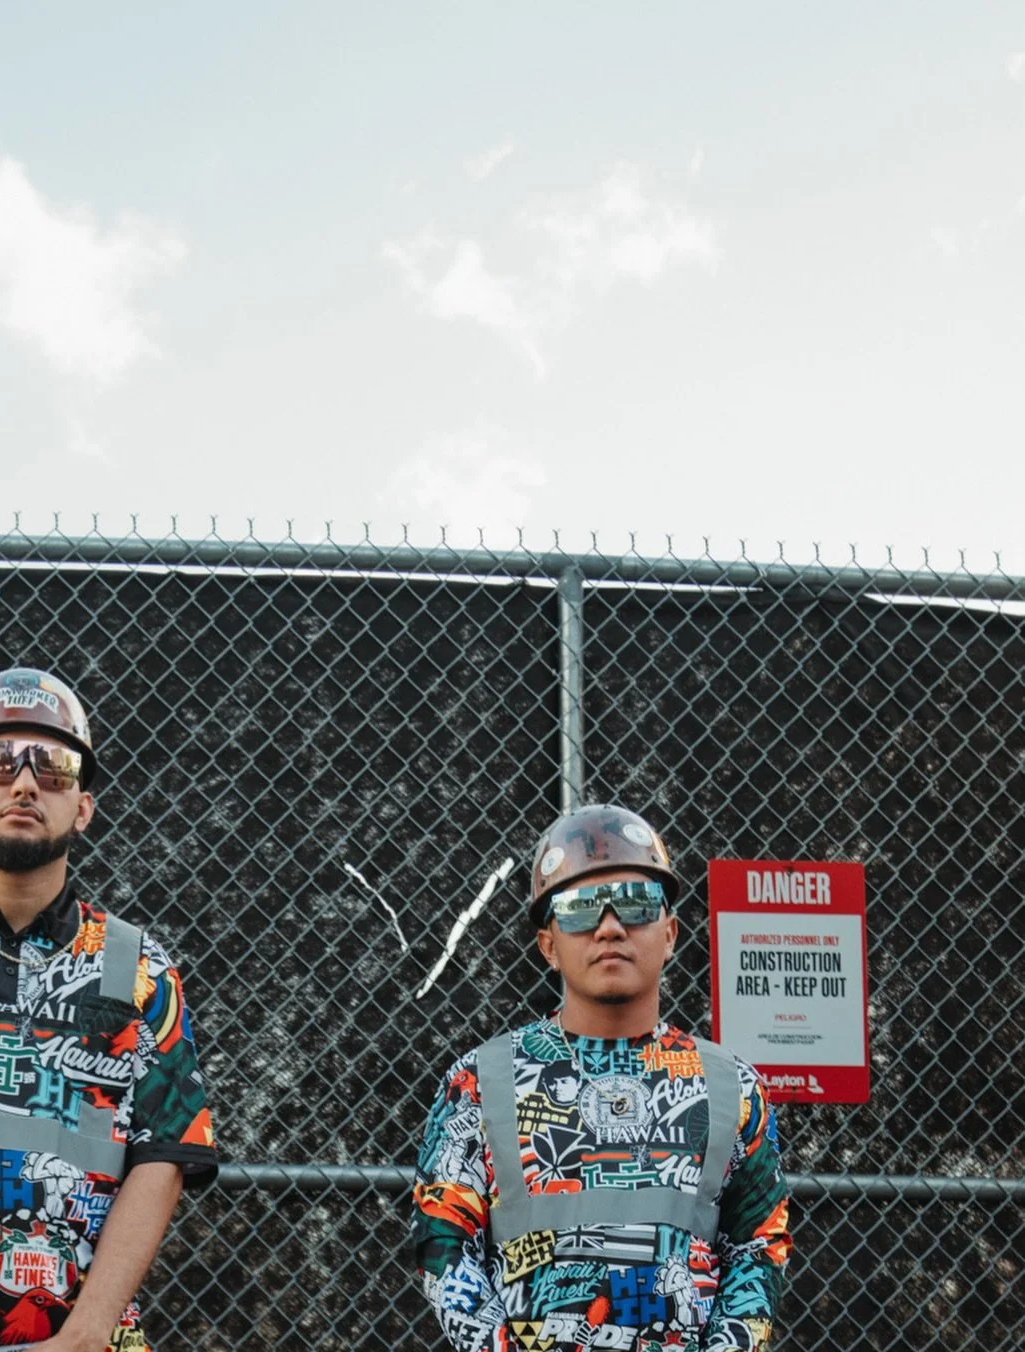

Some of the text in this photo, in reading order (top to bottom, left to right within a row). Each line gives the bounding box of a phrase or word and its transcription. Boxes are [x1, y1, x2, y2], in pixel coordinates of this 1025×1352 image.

[746, 870, 831, 905] DANGER
[741, 934, 839, 947] AUTHORIZED PERSONNEL ONLY
[740, 950, 842, 973] CONSTRUCTION
[735, 976, 771, 997] AREA
[783, 976, 818, 998] KEEP
[821, 977, 847, 998] OUT
[36, 1036, 134, 1086] Hawaii
[763, 1073, 805, 1090] Layton
[595, 1123, 686, 1145] HAWAII
[529, 1261, 607, 1292] Hawaii's
[531, 1281, 601, 1318] Finest
